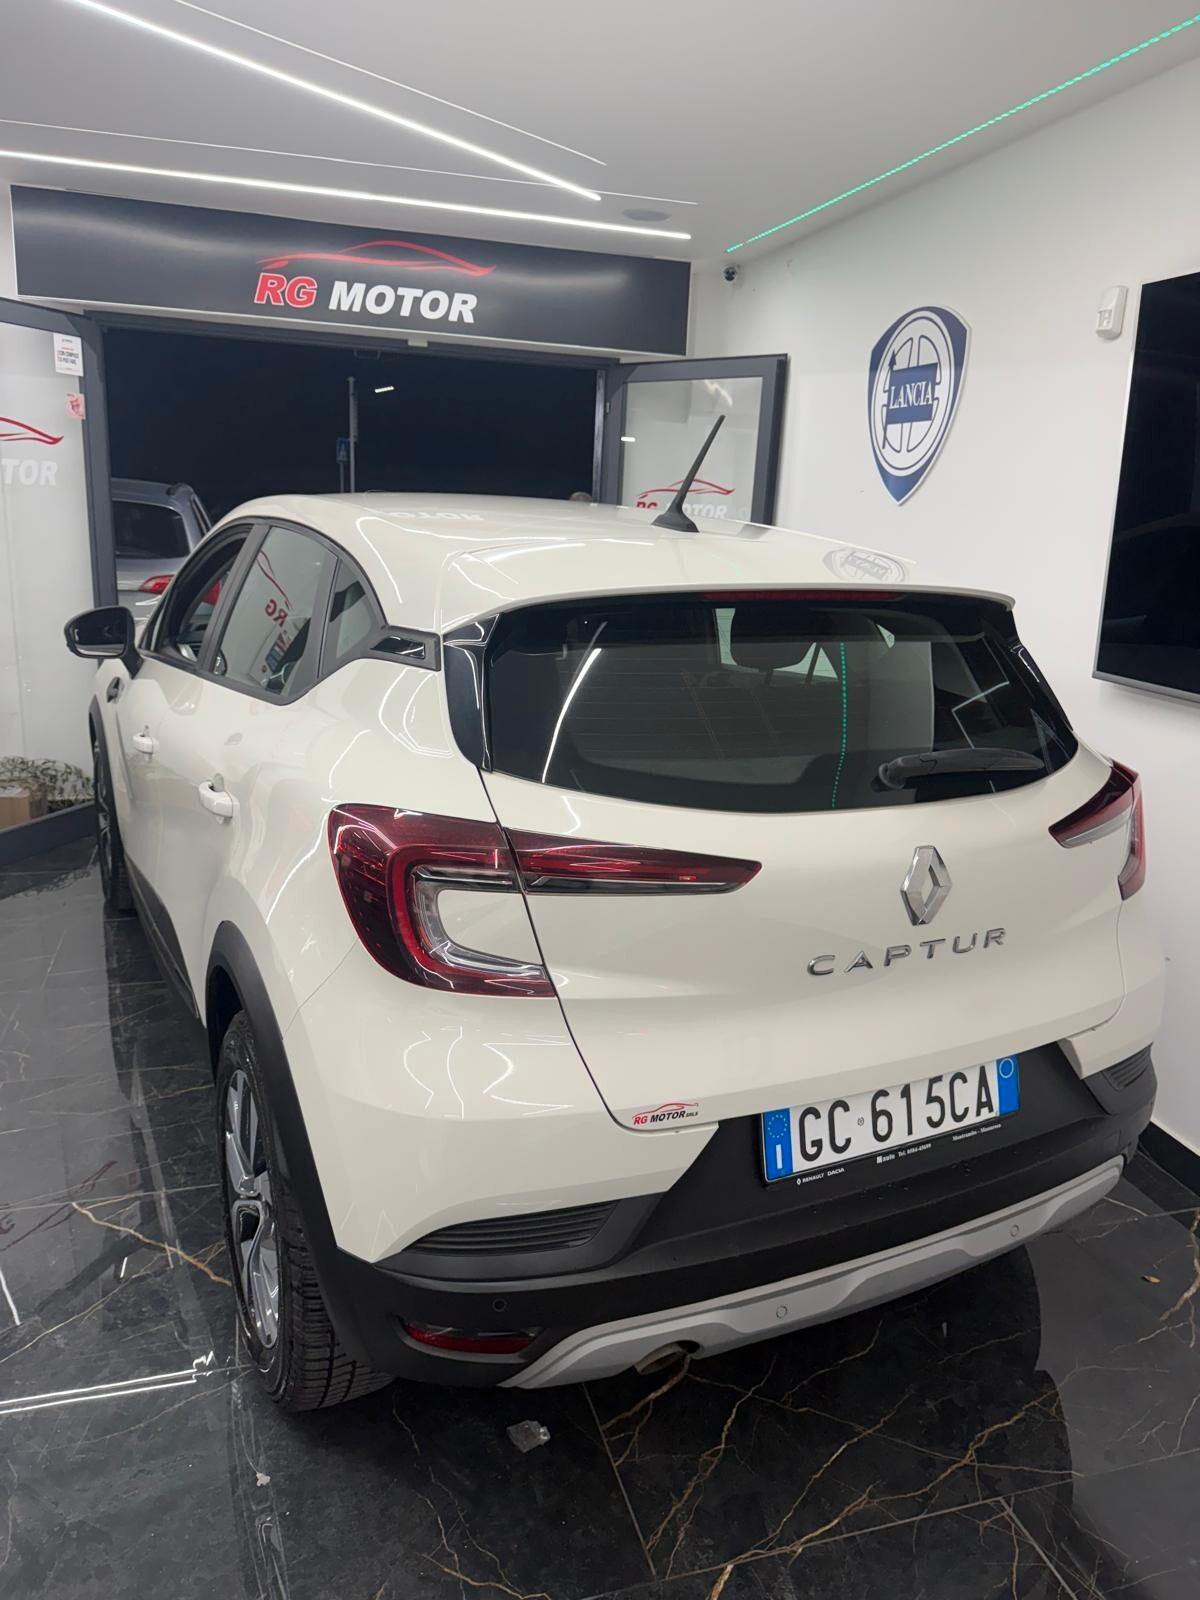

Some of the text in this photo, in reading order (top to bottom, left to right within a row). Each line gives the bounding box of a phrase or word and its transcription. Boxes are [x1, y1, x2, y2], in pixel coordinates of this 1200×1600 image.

[254, 272, 478, 323] RG MOTOR
[889, 381, 933, 409] LANCIA
[806, 927, 1006, 976] CAPTUR
[633, 1116, 648, 1126] RG
[649, 1110, 686, 1123] MOTOR
[799, 1099, 852, 1162] GC
[870, 1065, 995, 1142] 615CA
[802, 1173, 825, 1183] RENAULT
[827, 1167, 845, 1176] DACIA
